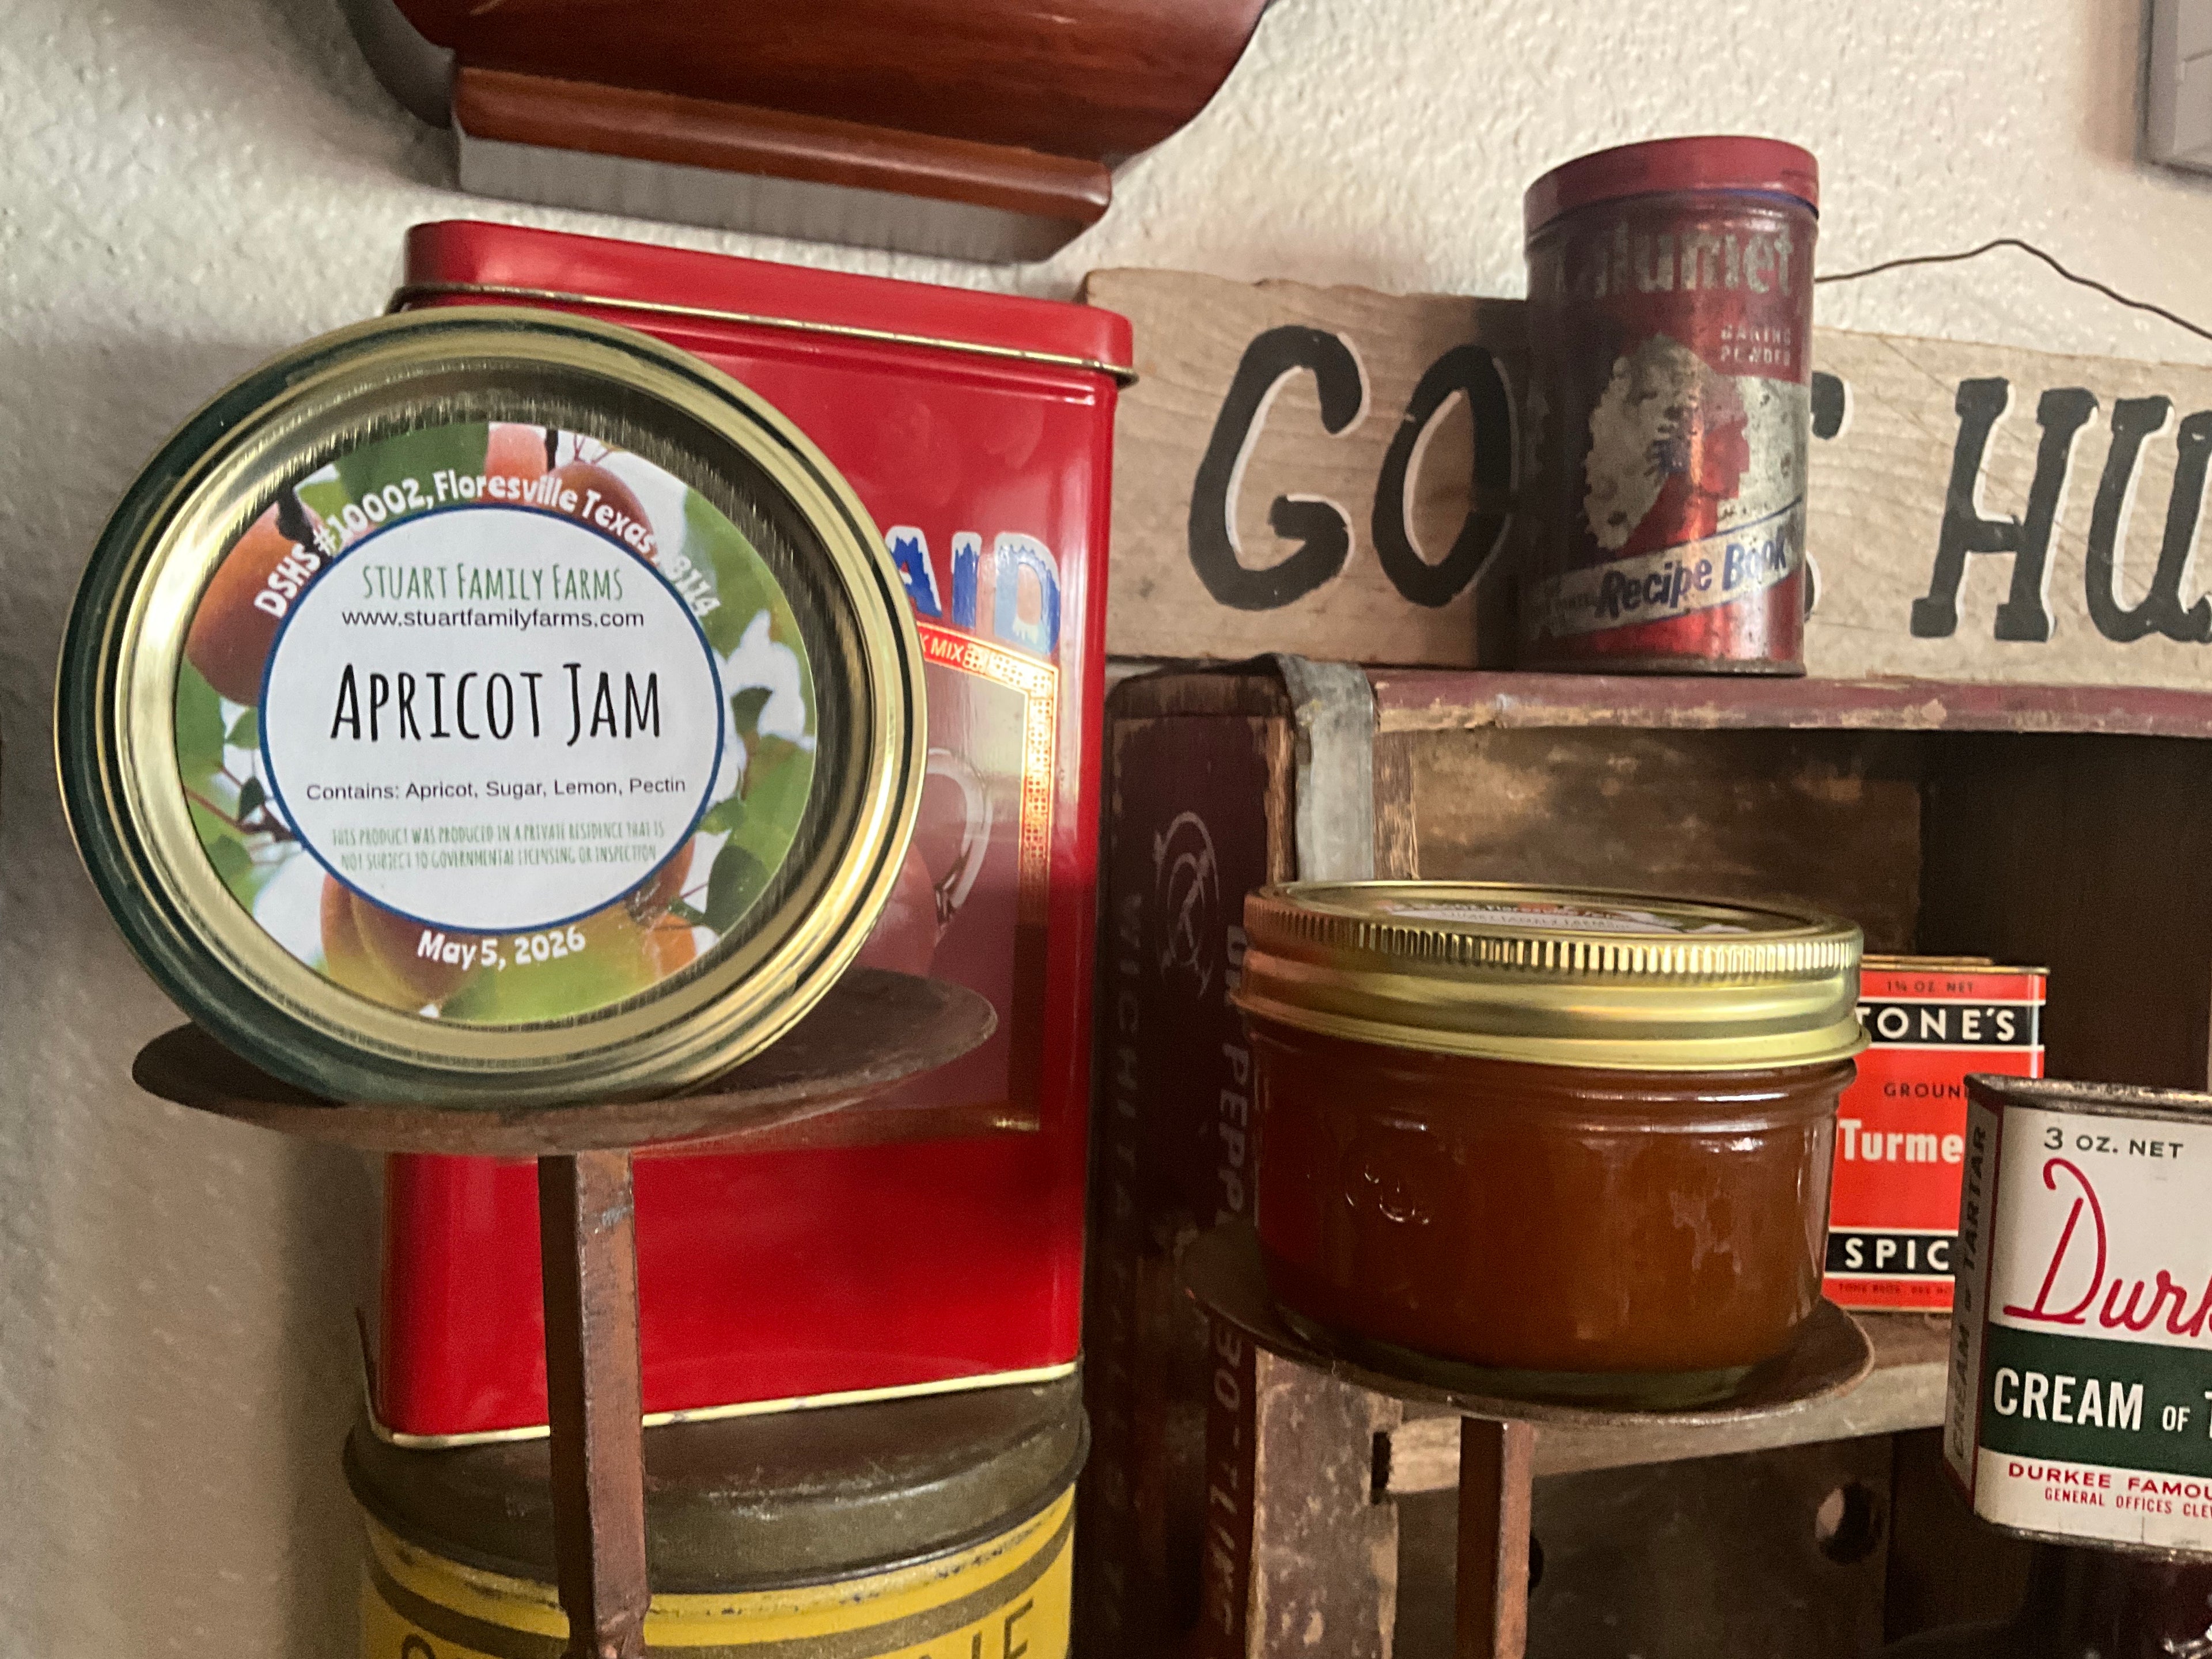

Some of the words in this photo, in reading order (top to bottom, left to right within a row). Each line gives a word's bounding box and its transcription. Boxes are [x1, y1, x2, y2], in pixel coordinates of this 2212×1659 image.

[254, 543, 321, 616] DSHS
[313, 478, 434, 556] #10002,
[433, 469, 578, 513] Floresville
[651, 544, 721, 616] 8114
[363, 563, 447, 600] STUART
[457, 563, 543, 600] FAMILY
[552, 563, 623, 600] FARMS
[1594, 559, 1712, 620] Recipe
[1722, 525, 1787, 591] Book
[343, 608, 645, 631] www.stuartfamilyfarms.com
[931, 637, 964, 663] MIX
[331, 663, 543, 742] APRICOT
[563, 662, 660, 747] JAM
[306, 782, 399, 800] Contains:
[406, 781, 478, 801] Apricot,
[486, 781, 546, 800] Sugar,
[555, 778, 622, 796] Lemon,
[630, 777, 685, 794] Pectin
[332, 828, 355, 846] THIS
[359, 827, 407, 846] PRODUCT
[411, 827, 435, 844] WAS
[438, 824, 493, 844] PRODUCED
[498, 824, 510, 842] IN
[524, 822, 564, 841] PRIVATE
[569, 821, 622, 840] RESIDENCE
[627, 820, 650, 837] THAT
[367, 852, 411, 870] SUBJECT
[415, 851, 428, 869] TO
[431, 848, 513, 869] GOVERNMENTAL
[518, 846, 575, 865] LICENSING
[579, 846, 592, 863] OR
[596, 844, 656, 863] INSPECTION
[417, 930, 478, 971] May
[481, 938, 506, 972] 5,
[514, 925, 586, 965] 2026
[1946, 981, 1974, 993] NET
[1884, 1082, 1968, 1099] GROUN
[1839, 1119, 1964, 1163] Turme
[2044, 1127, 2063, 1150] 3
[2076, 1135, 2118, 1154] OZ.
[2129, 1139, 2183, 1159] NET
[1963, 1126, 1987, 1271] TARTAR
[1845, 1237, 1949, 1271] SPIC
[1994, 1368, 2143, 1431] CREAM
[2162, 1406, 2190, 1432] OF
[2009, 1461, 2111, 1488] DURKEE
[2046, 1487, 2105, 1507] GENERAL
[2116, 1495, 2172, 1514] OFFICES
[2183, 1503, 2212, 1519] CLE
